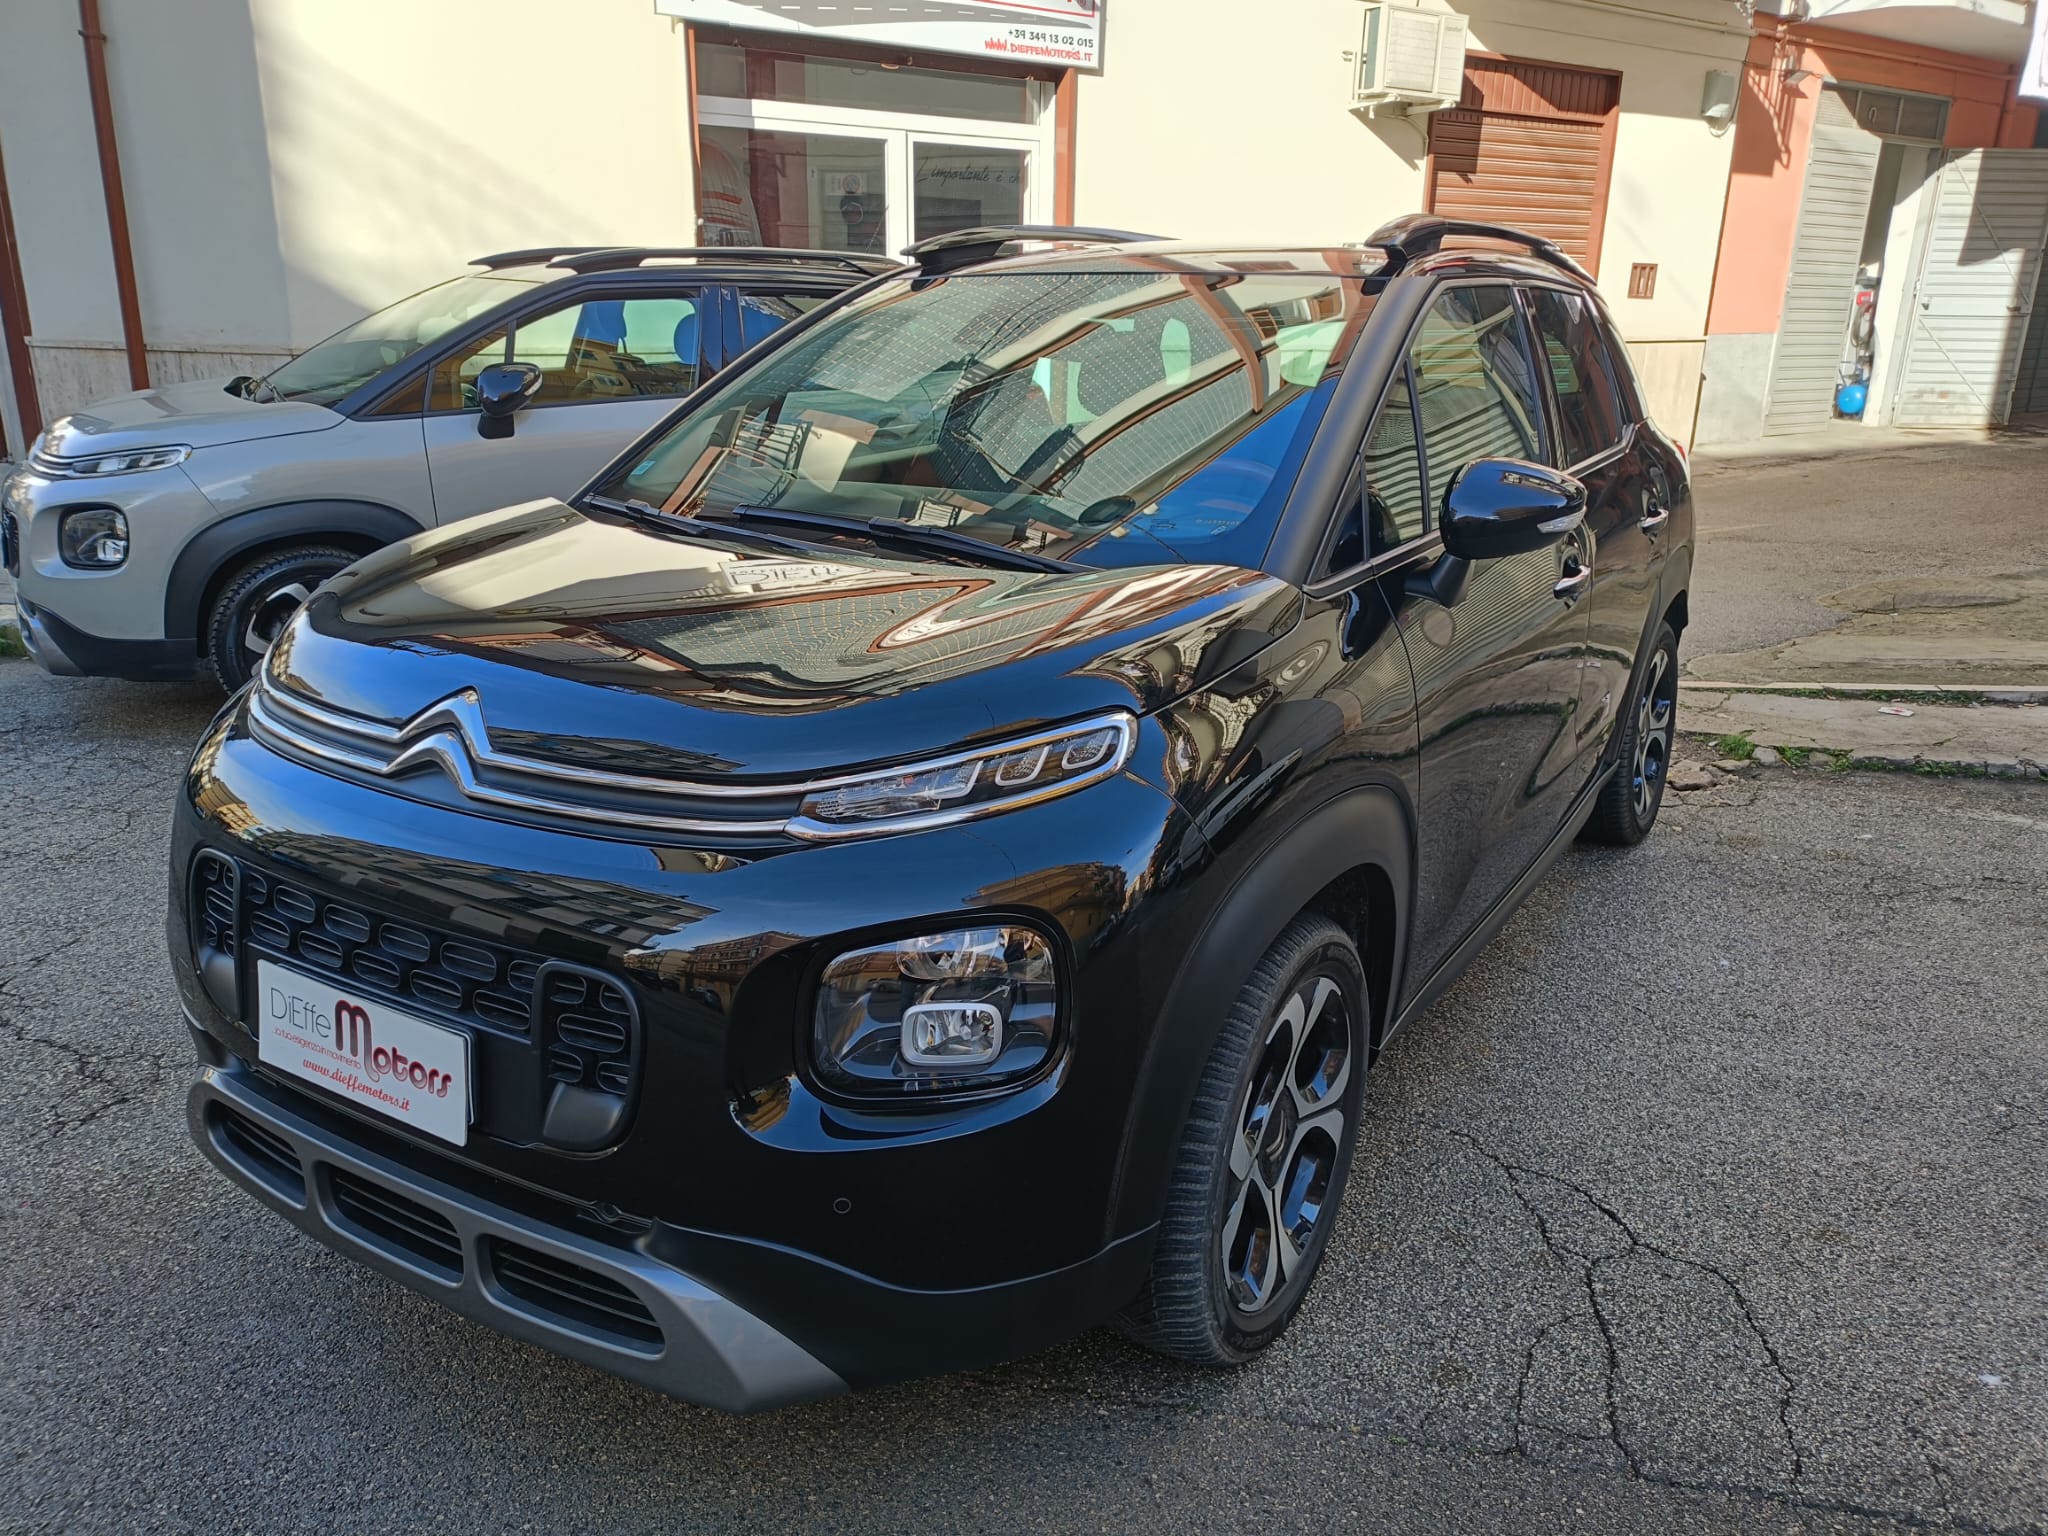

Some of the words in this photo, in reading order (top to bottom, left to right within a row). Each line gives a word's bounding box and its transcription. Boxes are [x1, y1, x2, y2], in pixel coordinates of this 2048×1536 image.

[1008, 29, 1026, 39] +39
[1029, 31, 1046, 42] 349
[1049, 34, 1059, 44] 13
[1062, 36, 1074, 46] 02
[1077, 37, 1094, 48] 015
[270, 987, 331, 1038] DiEffe
[303, 1058, 411, 1112] www.dieffemotors.it
